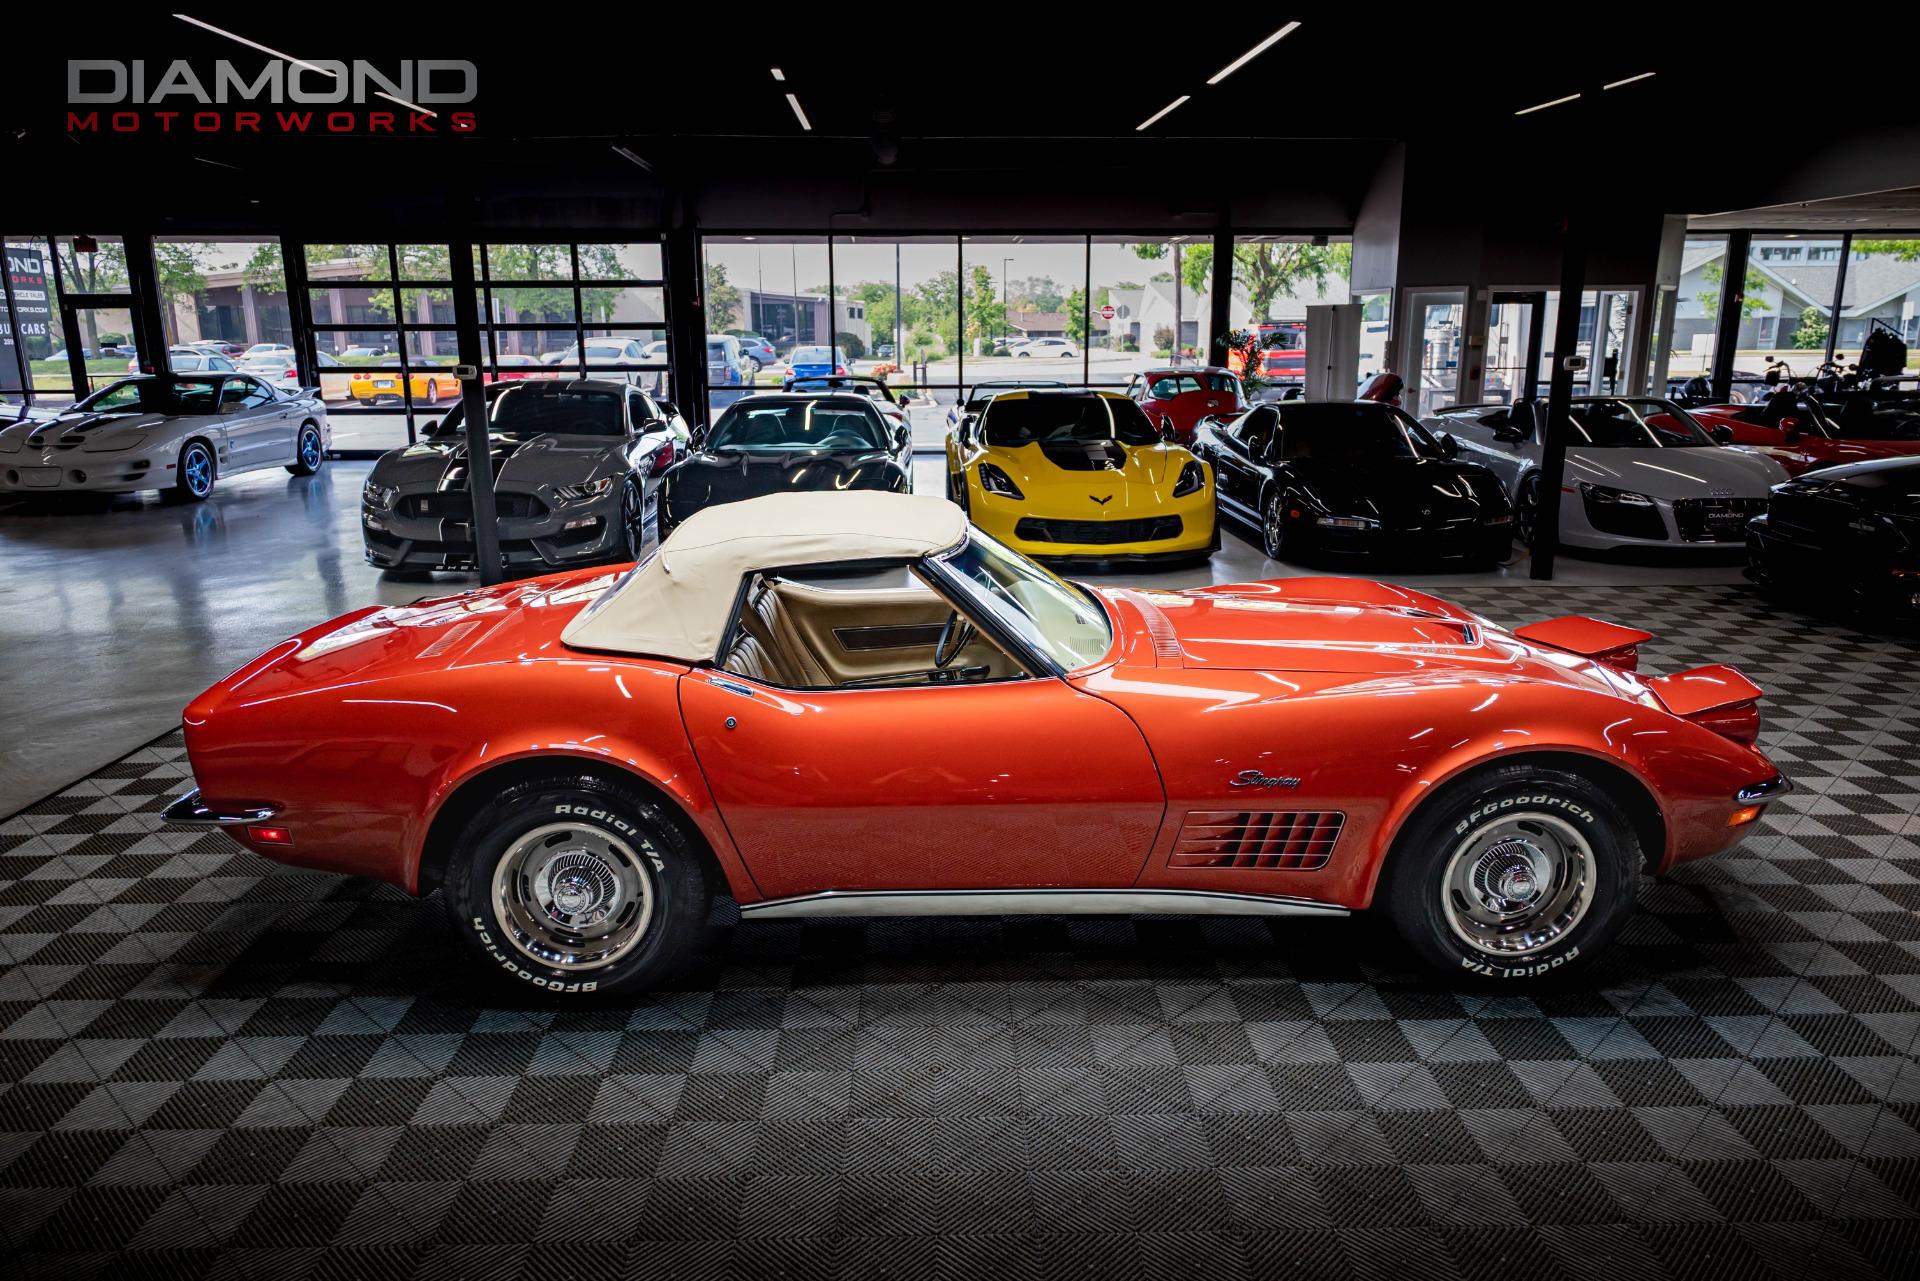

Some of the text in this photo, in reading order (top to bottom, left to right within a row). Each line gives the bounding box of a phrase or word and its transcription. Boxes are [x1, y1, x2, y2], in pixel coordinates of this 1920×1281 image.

[12, 275, 43, 284] ORKS
[0, 323, 46, 335] BU CARS
[1229, 769, 1301, 790] Stingray
[1455, 794, 1594, 835] BFGoodrich
[555, 804, 666, 874] Radial T/A
[473, 916, 598, 992] BFGoodrich
[1502, 946, 1580, 979] Radial
